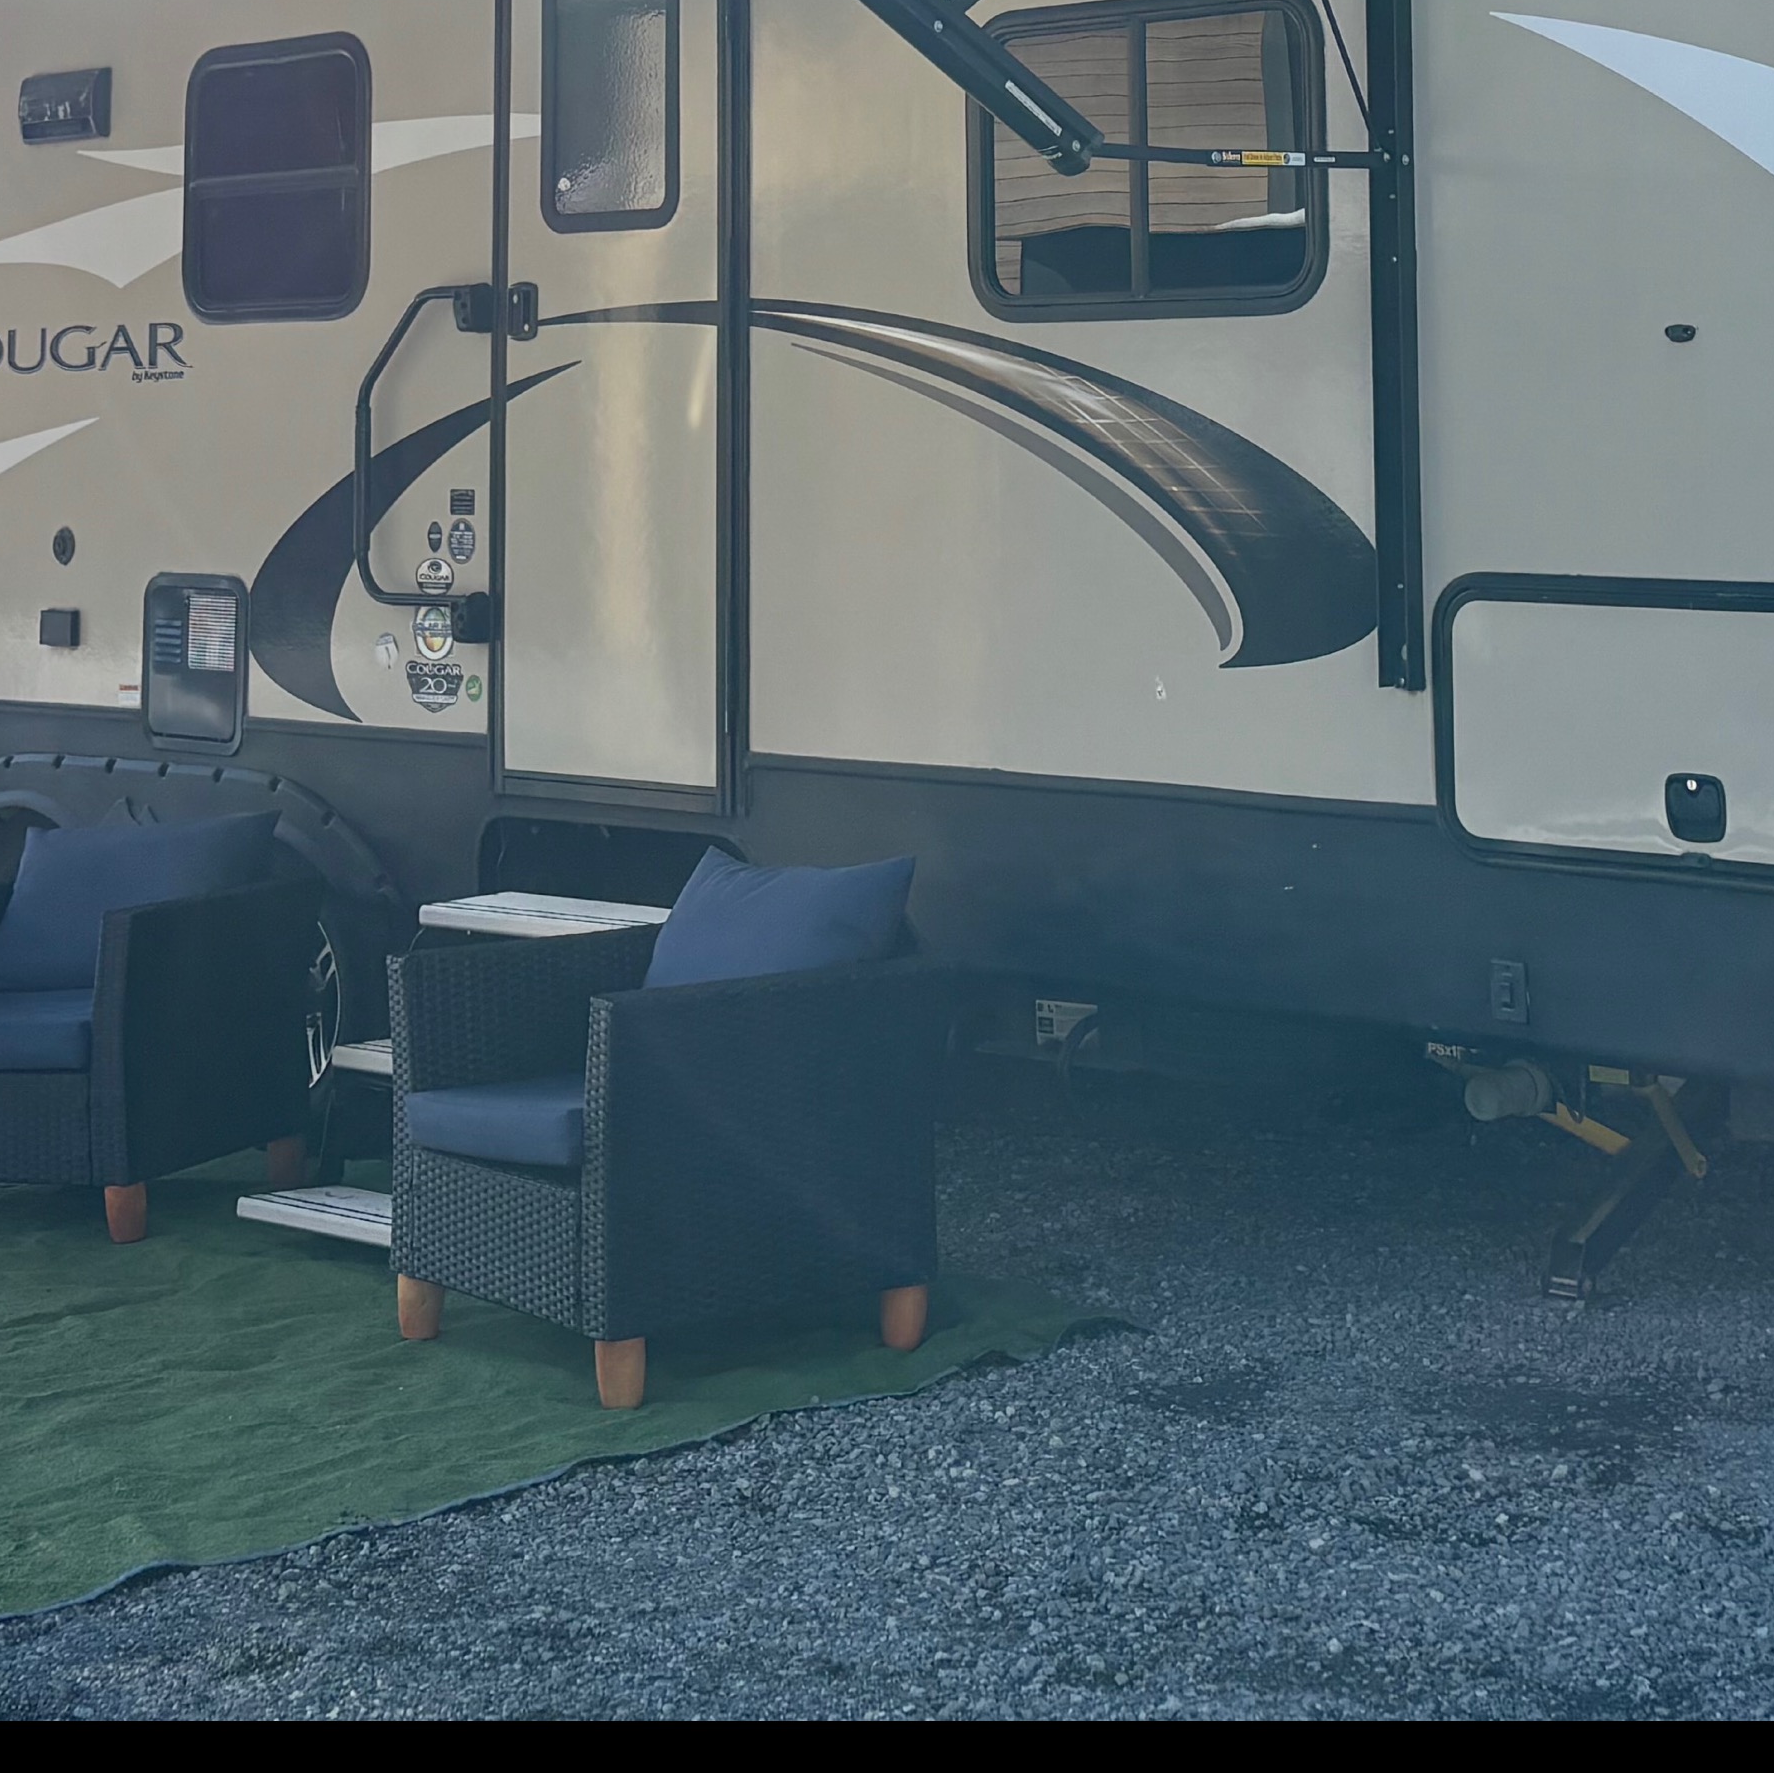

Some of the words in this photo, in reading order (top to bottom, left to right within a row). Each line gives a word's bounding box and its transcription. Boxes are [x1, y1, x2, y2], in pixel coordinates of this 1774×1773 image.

[132, 371, 143, 384] by
[144, 371, 184, 383] Keystone
[407, 663, 462, 676] COUGAR
[419, 677, 448, 694] 20
